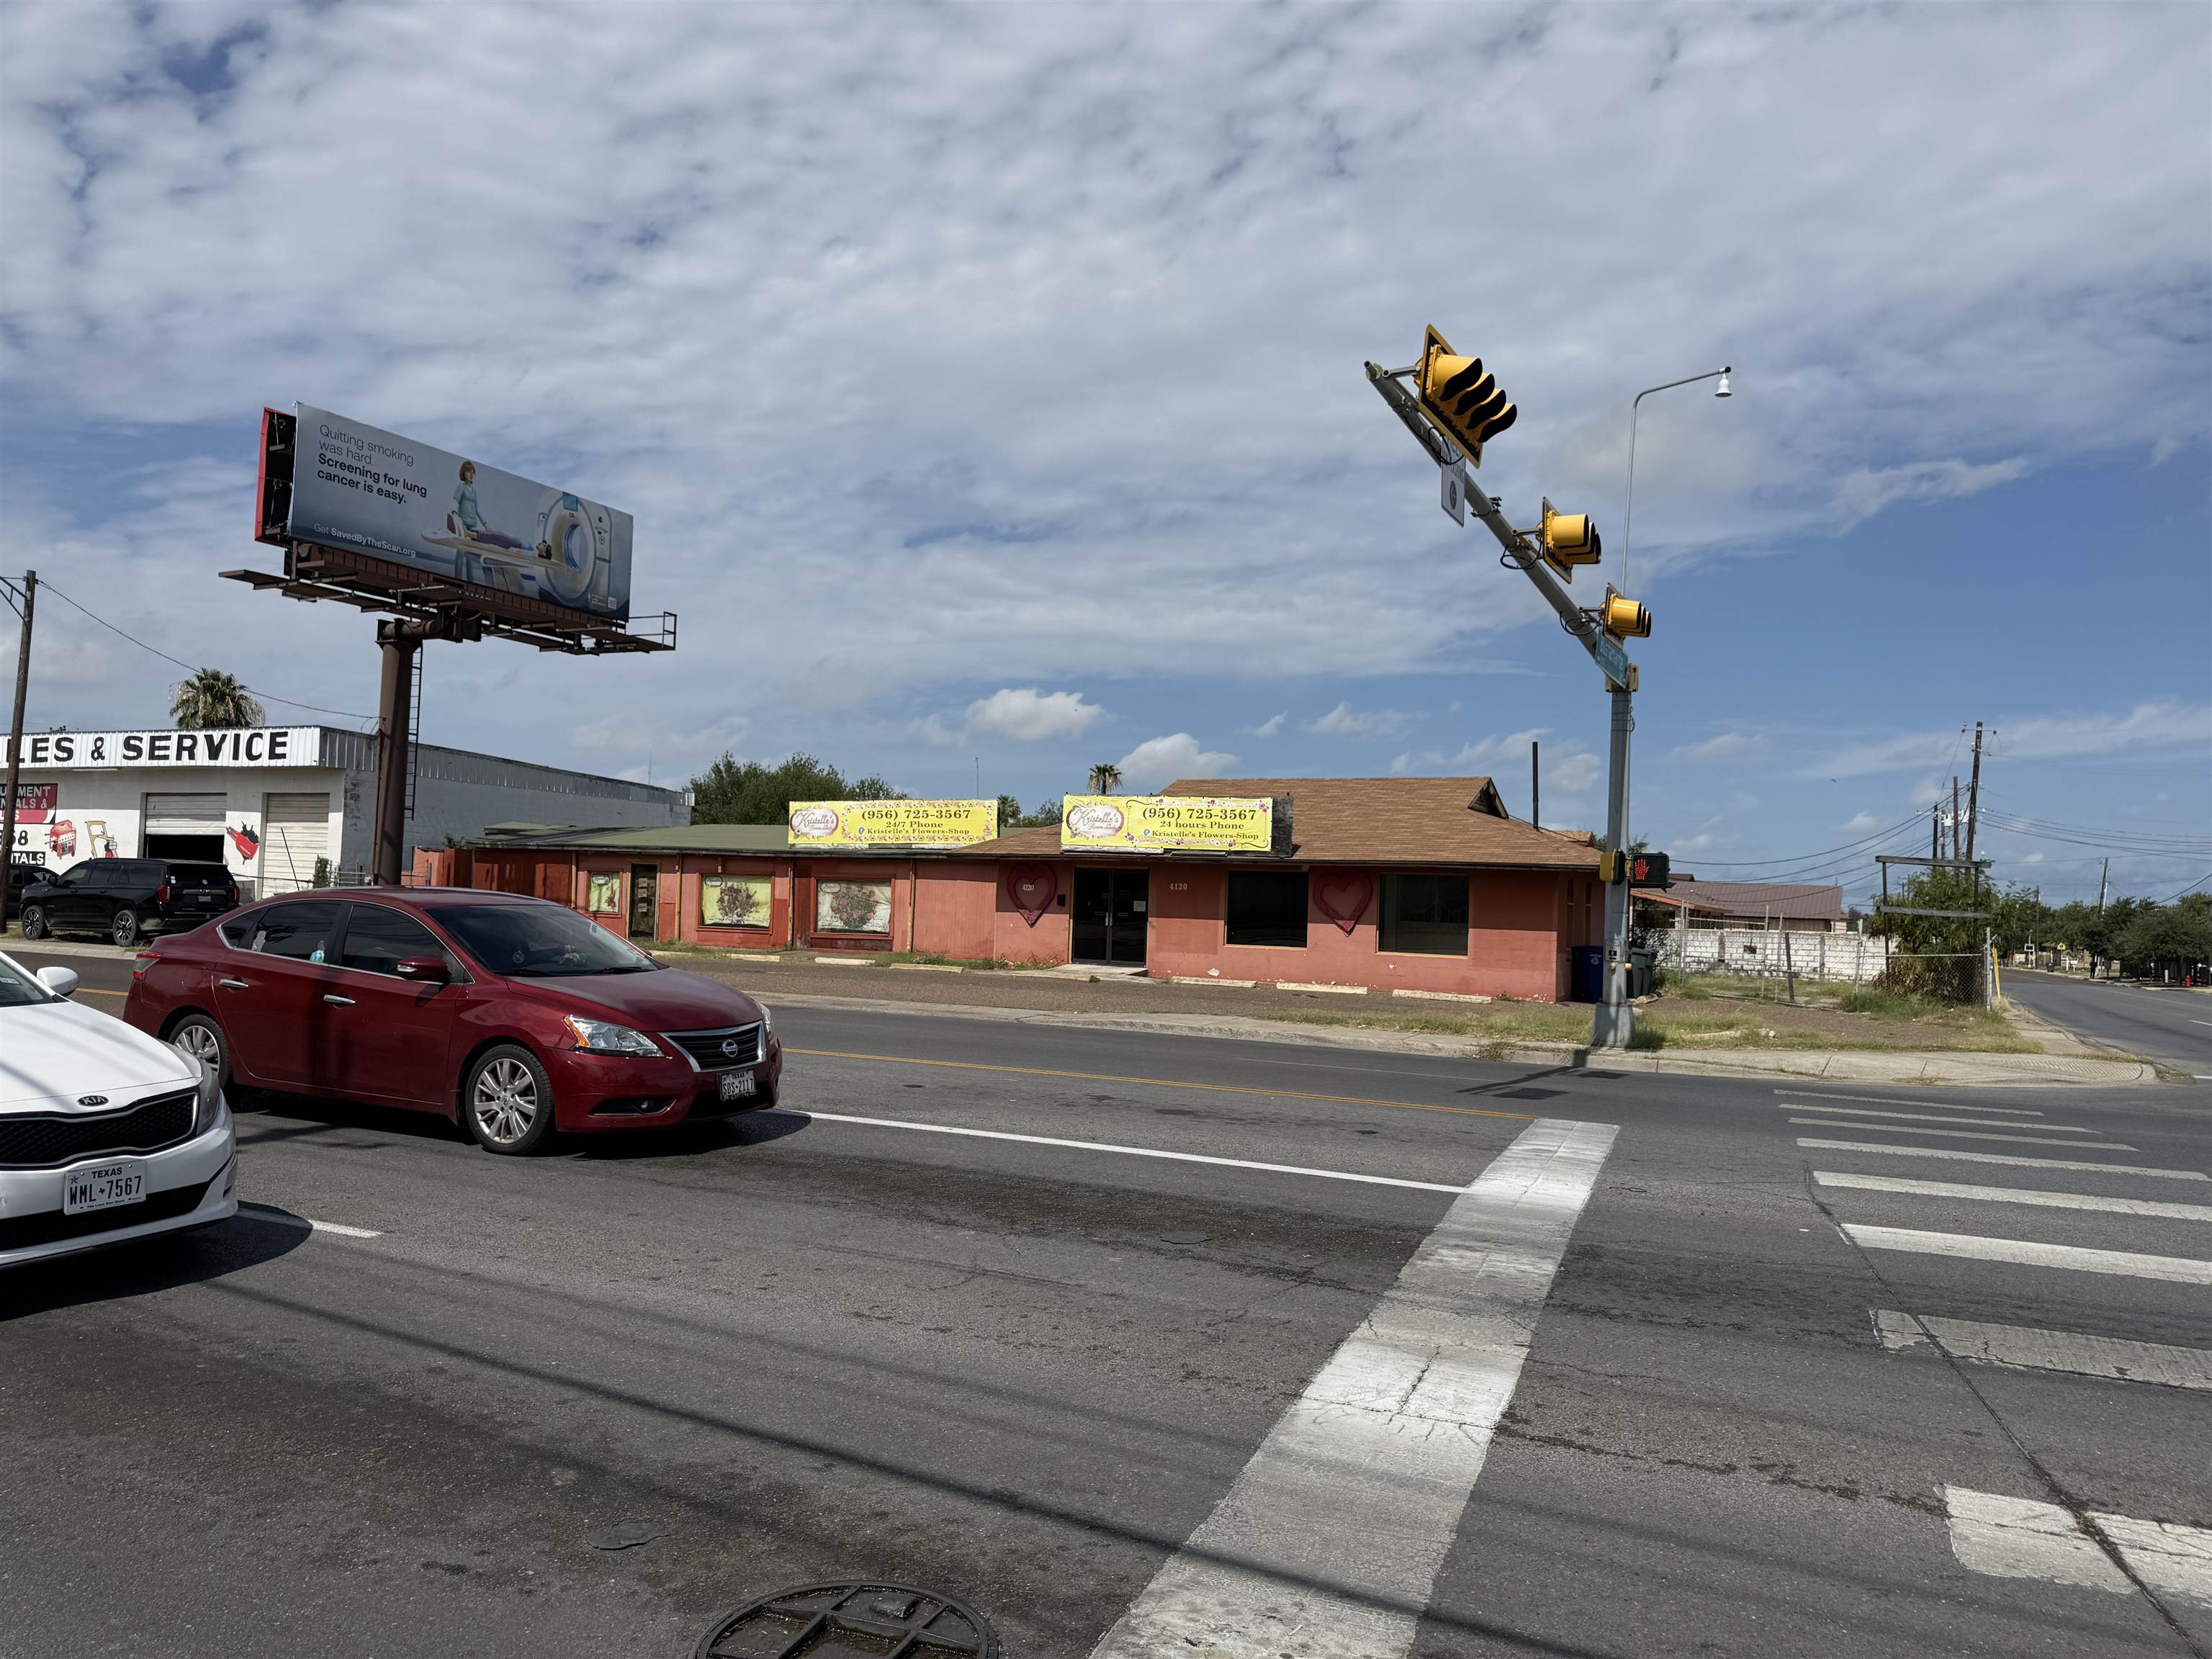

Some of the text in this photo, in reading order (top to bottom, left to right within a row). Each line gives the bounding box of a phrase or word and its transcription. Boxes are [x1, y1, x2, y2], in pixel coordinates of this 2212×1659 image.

[320, 425, 414, 467] Quitting smoking
[319, 441, 374, 466] was hard.
[318, 453, 427, 498] Screening for lung
[318, 469, 407, 504] cancer is easy.
[314, 523, 415, 558] Get SavedByTheScan.org
[91, 737, 105, 761] &
[122, 731, 289, 761] SERVICE
[41, 799, 48, 809] &
[862, 809, 971, 821] (956) 725-3567
[1143, 808, 1256, 821] (956) 725-3567
[1210, 821, 1244, 830] Phone
[1198, 831, 1259, 840] Flowers-Shop
[82, 1096, 107, 1105] KIA
[92, 1167, 122, 1179] TEXAS
